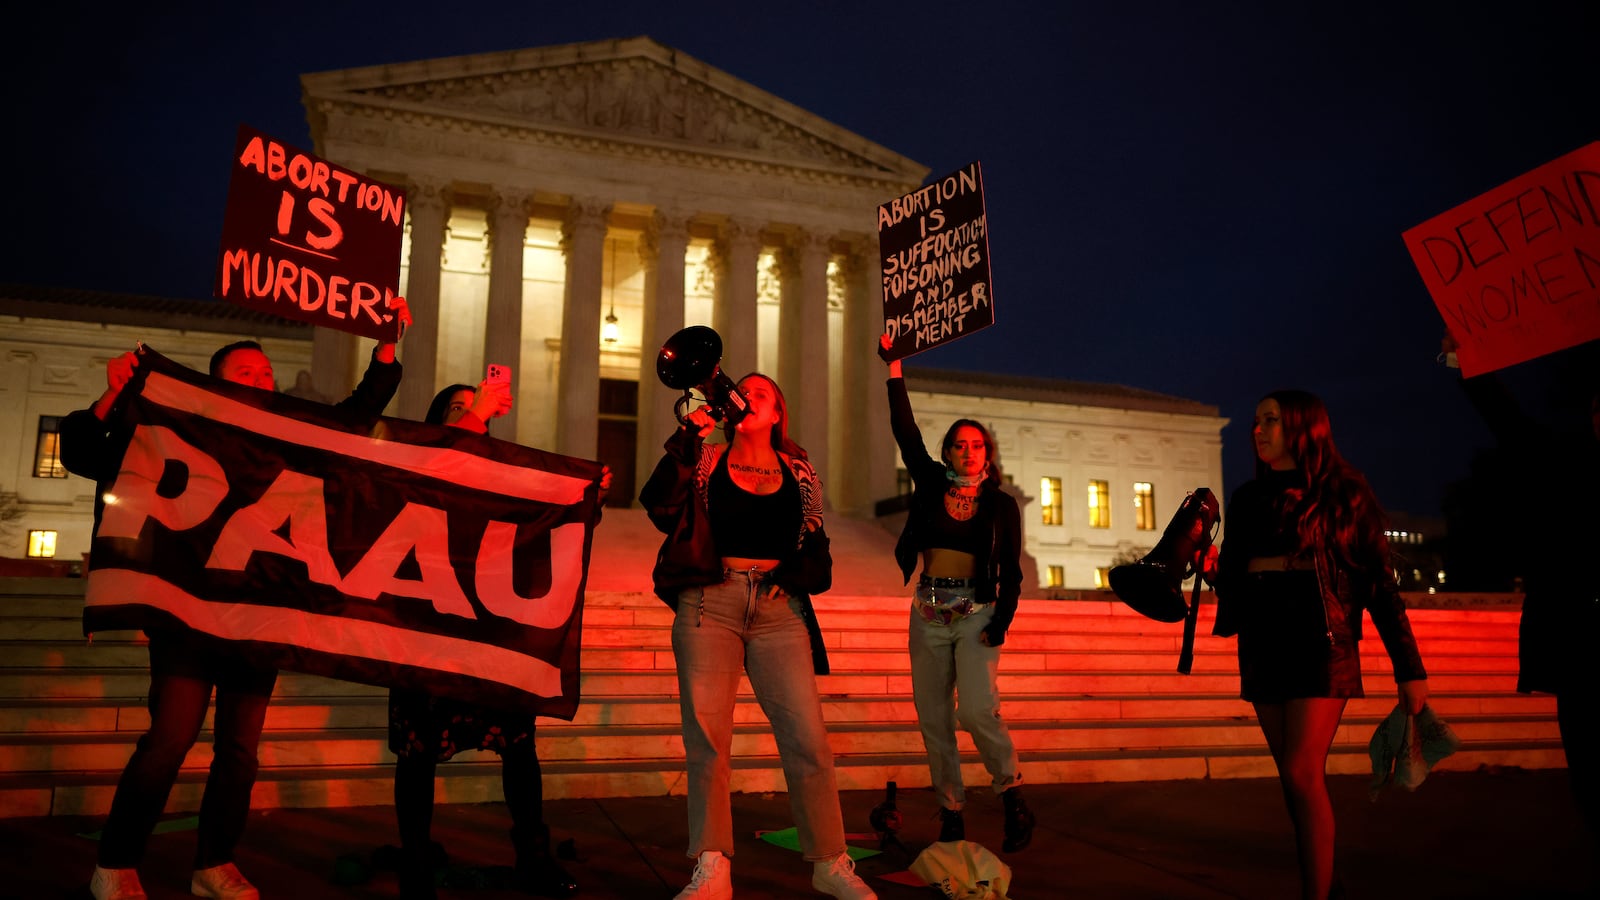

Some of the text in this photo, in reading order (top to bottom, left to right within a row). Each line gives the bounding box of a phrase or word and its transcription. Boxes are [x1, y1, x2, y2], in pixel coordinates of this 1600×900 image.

[240, 136, 403, 227] ABORTION
[878, 163, 977, 232] ABORTION
[277, 190, 344, 251] IS
[920, 209, 945, 238] IS
[222, 248, 393, 325] MURDER!
[884, 243, 982, 302] POISONING
[913, 278, 954, 311] AND
[886, 282, 988, 343] DISMEMBER
[916, 313, 966, 349] MENT
[96, 423, 585, 630] PAAU
